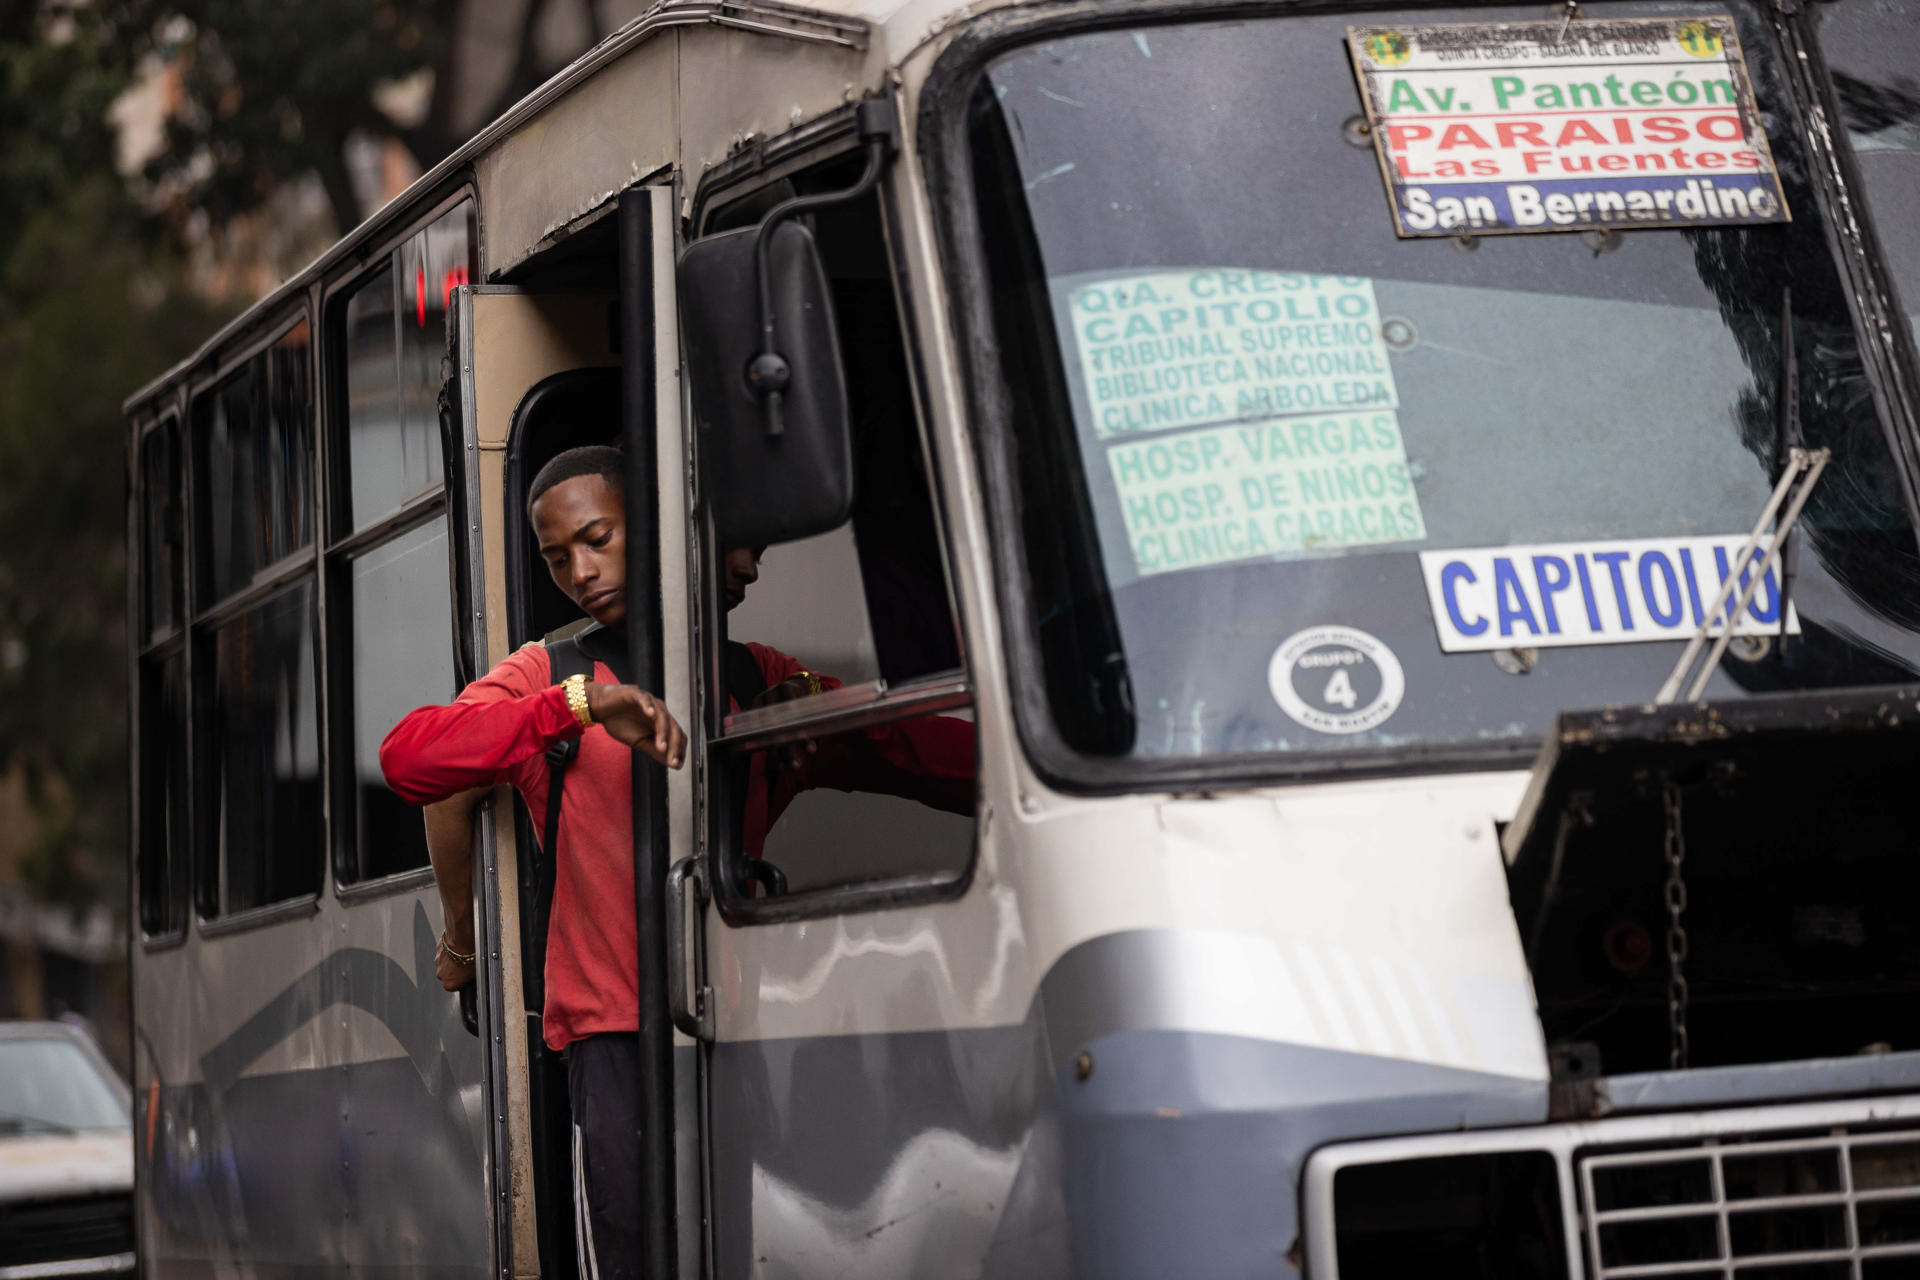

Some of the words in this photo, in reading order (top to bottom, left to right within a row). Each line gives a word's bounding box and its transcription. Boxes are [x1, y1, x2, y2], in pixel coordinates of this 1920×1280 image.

[1389, 78, 1472, 112] Av.
[1491, 71, 1736, 111] Panteón
[1387, 115, 1746, 150] PARAISO
[1396, 155, 1501, 179] Las
[1522, 146, 1760, 175] Fuentes
[1404, 185, 1499, 231] San
[1506, 178, 1780, 227] Bernardino
[1086, 295, 1370, 343] CAPITOLIO
[1089, 332, 1232, 372] TRIBUNAL
[1240, 321, 1374, 354] SUPREMO
[1095, 359, 1249, 402] BIBLIOTECA
[1256, 350, 1386, 382] NACIONAL
[1103, 393, 1225, 431] CLINICA
[1236, 381, 1391, 413] ARBOLEDA
[1116, 434, 1232, 486] HOSP.
[1239, 414, 1396, 463] VARGAS
[1127, 483, 1232, 530] HOSP.
[1240, 473, 1290, 511] DE
[1298, 459, 1410, 504] NIÑOS
[1137, 519, 1268, 568] CLINICA
[1275, 503, 1419, 542] CARACAS
[1441, 545, 1781, 637] CAPITOLIO
[1324, 668, 1357, 709] 4
